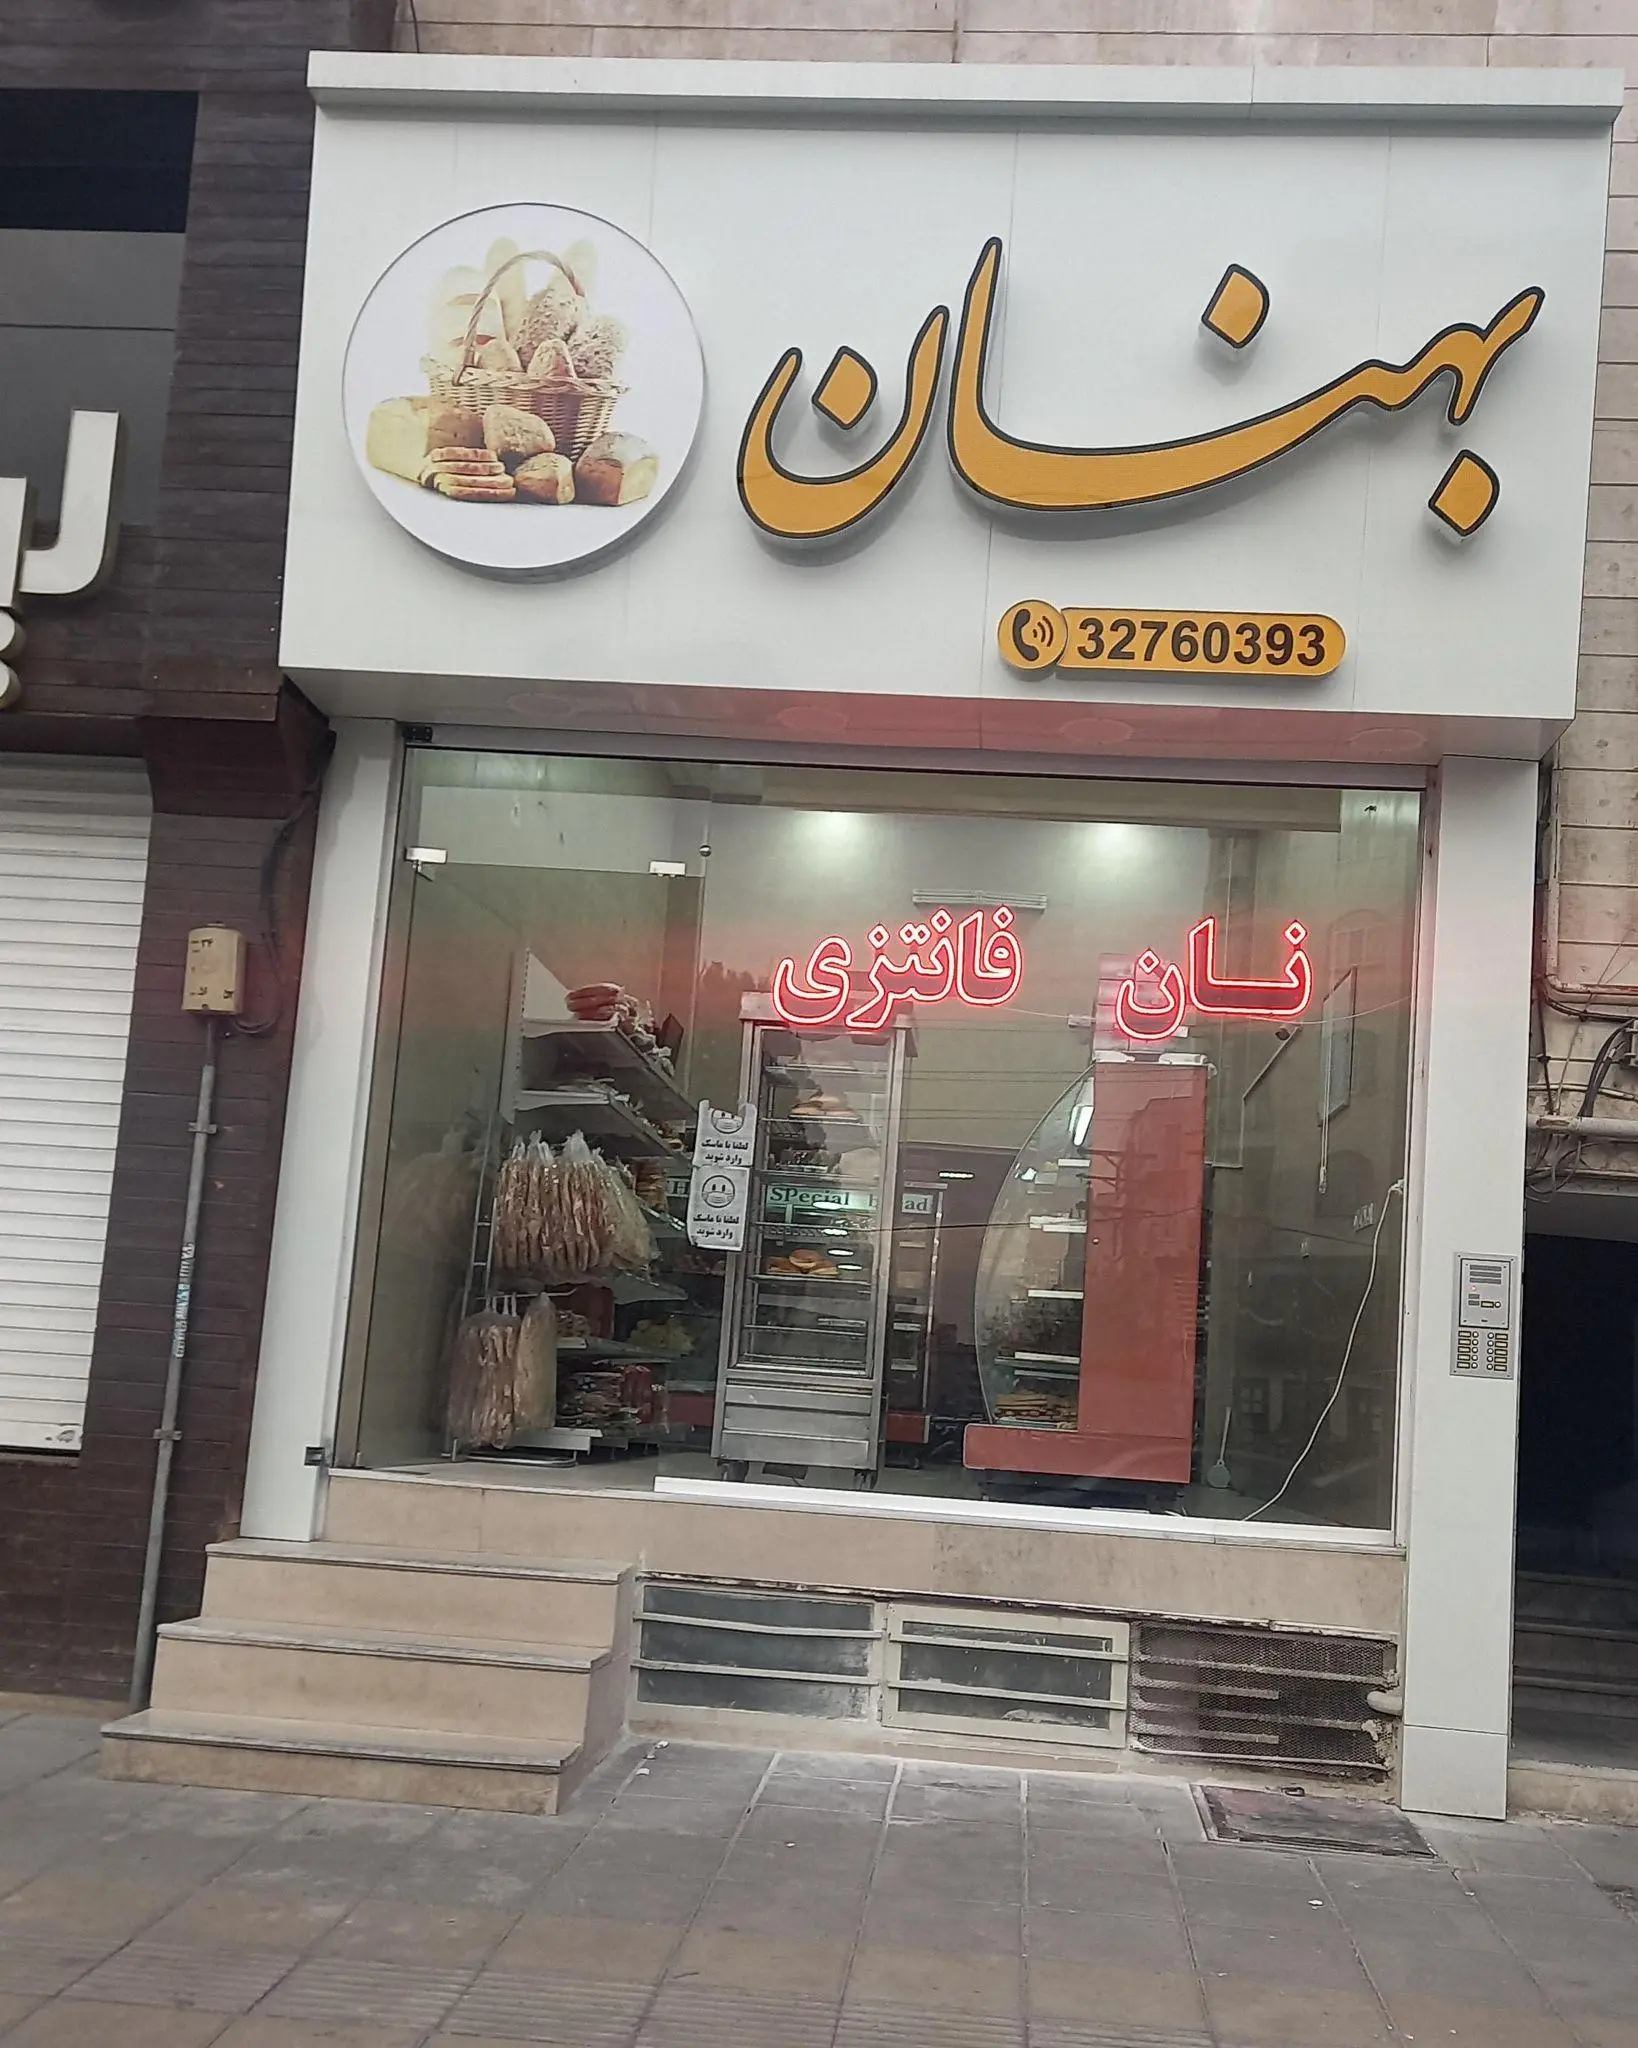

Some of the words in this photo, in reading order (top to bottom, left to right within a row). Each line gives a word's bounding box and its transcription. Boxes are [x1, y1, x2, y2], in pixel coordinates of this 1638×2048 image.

[1076, 617, 1326, 667] 32760393
[772, 904, 1023, 1031] فانتزی
[1114, 913, 1312, 1040] نان
